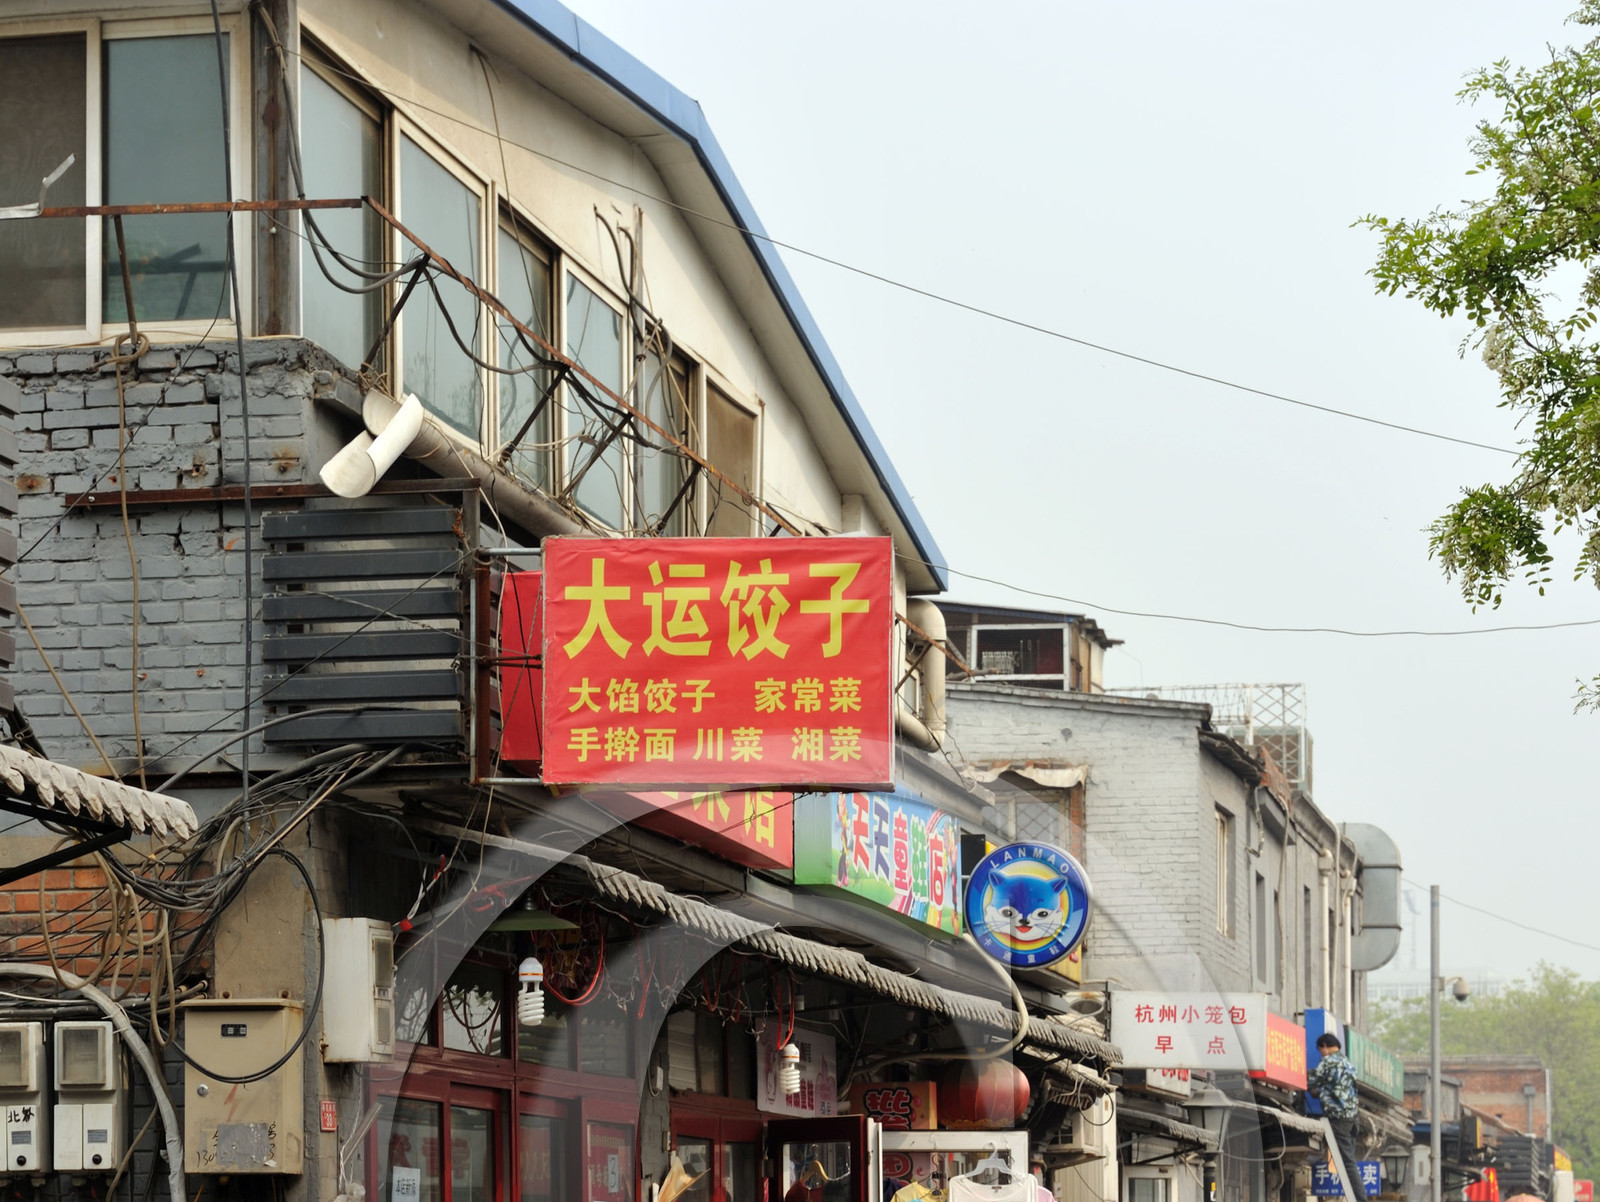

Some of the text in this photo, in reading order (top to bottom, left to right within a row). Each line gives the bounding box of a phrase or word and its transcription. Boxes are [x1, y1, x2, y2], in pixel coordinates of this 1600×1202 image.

[563, 558, 869, 660] 大运饺子
[568, 677, 862, 713] 大馅饺子 家常菜
[567, 727, 862, 763] 手擀面 川菜 湘菜
[853, 791, 944, 911] 天天童鞋店
[990, 847, 1070, 874] LANMAO
[1135, 1004, 1247, 1025] 杭州小笼包
[1155, 1036, 1226, 1054] 早点
